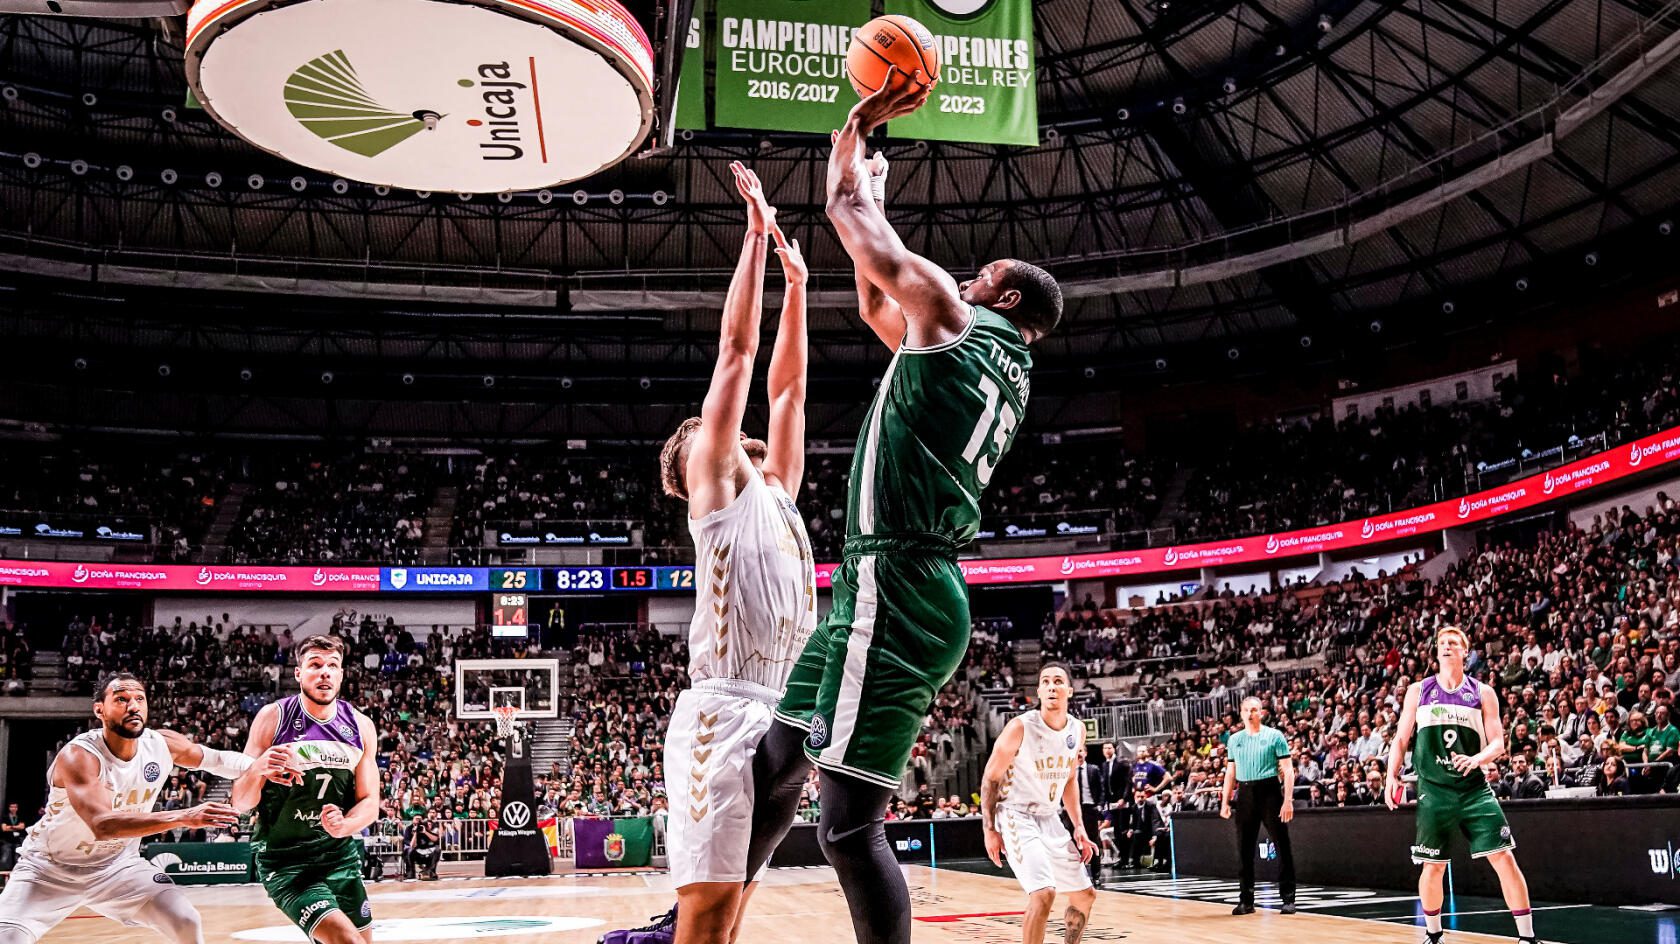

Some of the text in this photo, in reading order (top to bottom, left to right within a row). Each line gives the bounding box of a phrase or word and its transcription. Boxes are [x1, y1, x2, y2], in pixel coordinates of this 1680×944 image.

[934, 35, 1029, 70] PEONES
[947, 68, 987, 86] DEL
[993, 71, 1031, 88] REY
[748, 80, 839, 104] 2016/2017
[458, 61, 527, 161] Unicaja
[940, 95, 985, 115] 2023
[989, 339, 1030, 408] THOMA
[962, 373, 1016, 485] 15
[416, 573, 473, 585] UNICAJA
[502, 571, 527, 589] 25
[557, 570, 603, 589] 8:23
[619, 571, 646, 586] 1.5
[670, 571, 692, 587] 12
[494, 608, 525, 625] 1.4
[1443, 729, 1458, 749] 9
[320, 753, 349, 765] Unicaja
[316, 773, 333, 800] 7
[179, 861, 247, 873] Unicaja Banco
[299, 899, 330, 927] málaga
